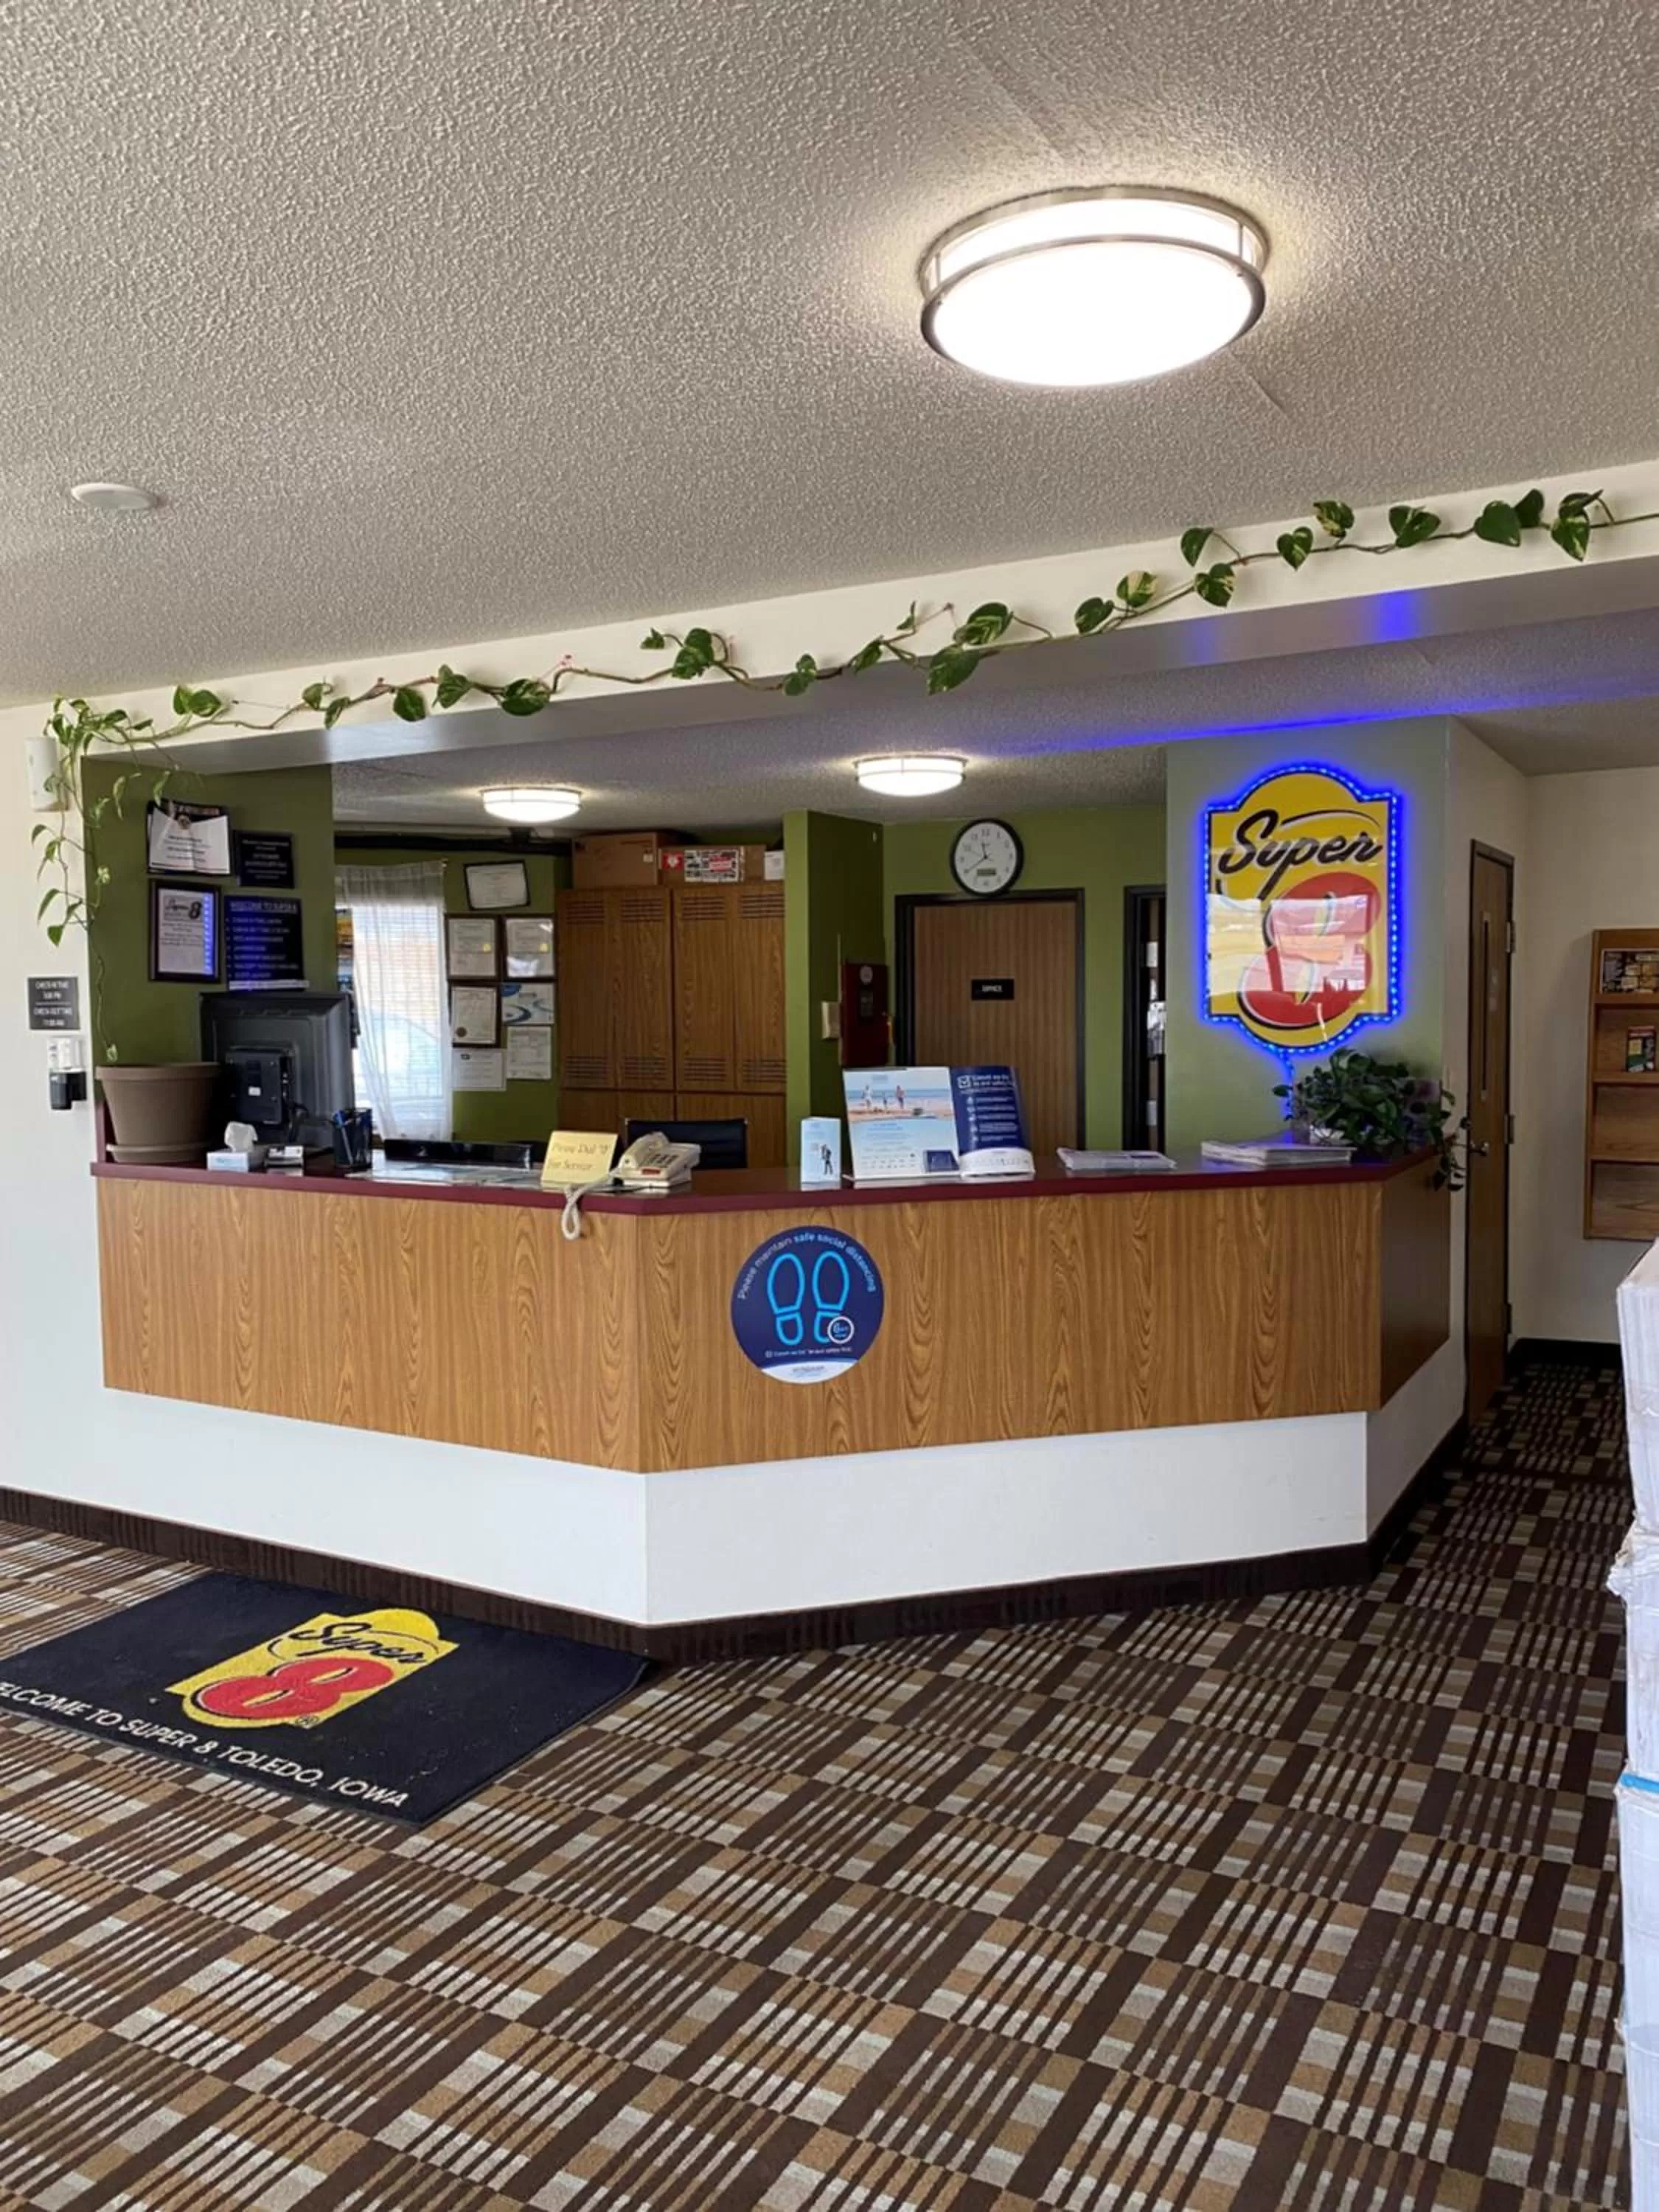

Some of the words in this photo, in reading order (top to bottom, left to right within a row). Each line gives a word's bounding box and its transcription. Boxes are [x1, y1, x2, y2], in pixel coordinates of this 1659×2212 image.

[1218, 809, 1383, 901] Super
[189, 901, 203, 920] 8
[737, 1267, 757, 1299] Please
[793, 1232, 815, 1244] safe
[817, 1234, 847, 1249] social
[845, 1246, 876, 1292] distancing
[288, 1622, 428, 1664] Super
[190, 1655, 394, 1721] 8
[0, 1682, 93, 1717] ELCOME
[84, 1707, 124, 1726] TO
[118, 1719, 198, 1748] SUPER
[192, 1740, 219, 1754] 8
[217, 1745, 324, 1787] TOLEDO,
[328, 1776, 410, 1807] IOWA
